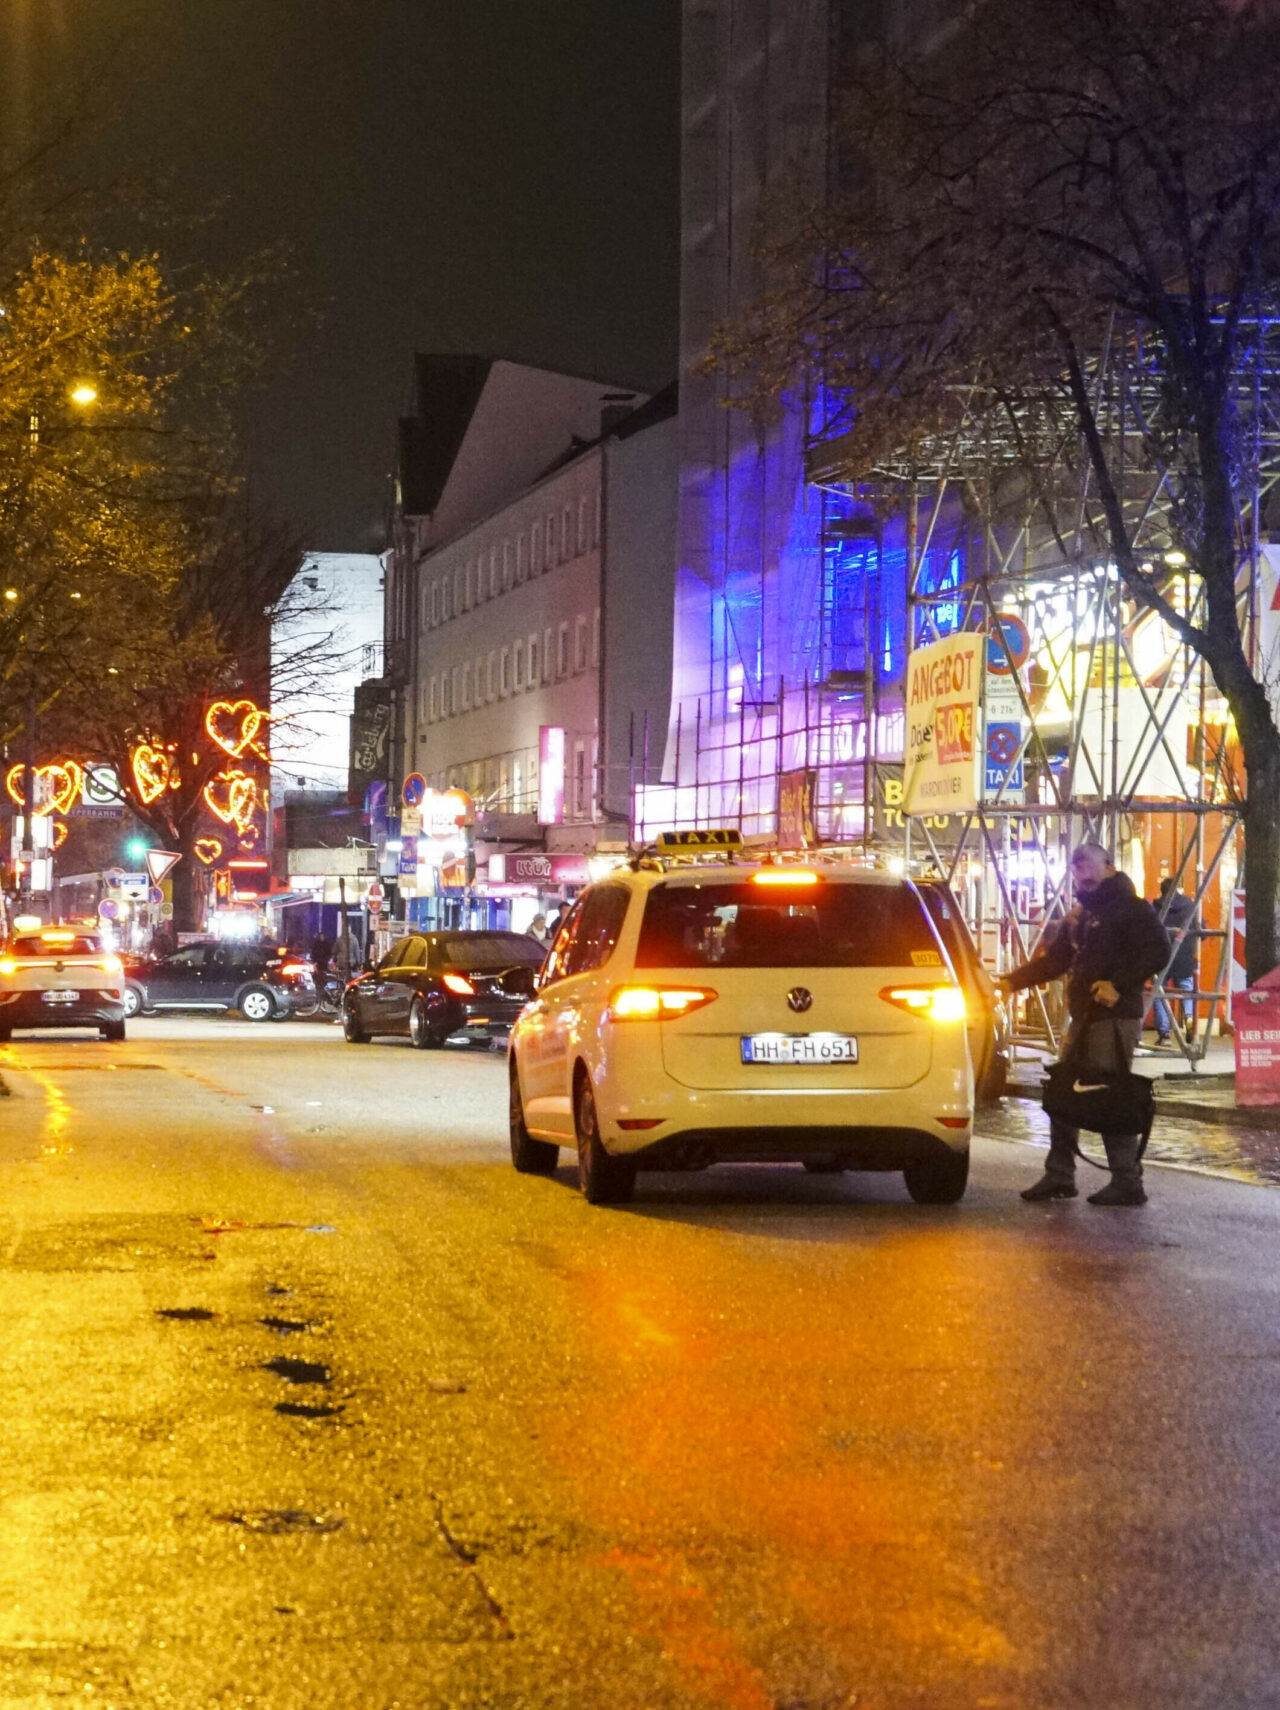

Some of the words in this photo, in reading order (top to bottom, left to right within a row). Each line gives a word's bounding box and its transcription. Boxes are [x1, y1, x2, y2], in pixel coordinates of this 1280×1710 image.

[910, 650, 974, 706] ANGEBOT
[673, 831, 730, 845] TAXI
[1240, 1030, 1261, 1041] LIEB
[754, 1041, 779, 1059] HH
[792, 1040, 816, 1059] FH
[821, 1040, 856, 1059] 651
